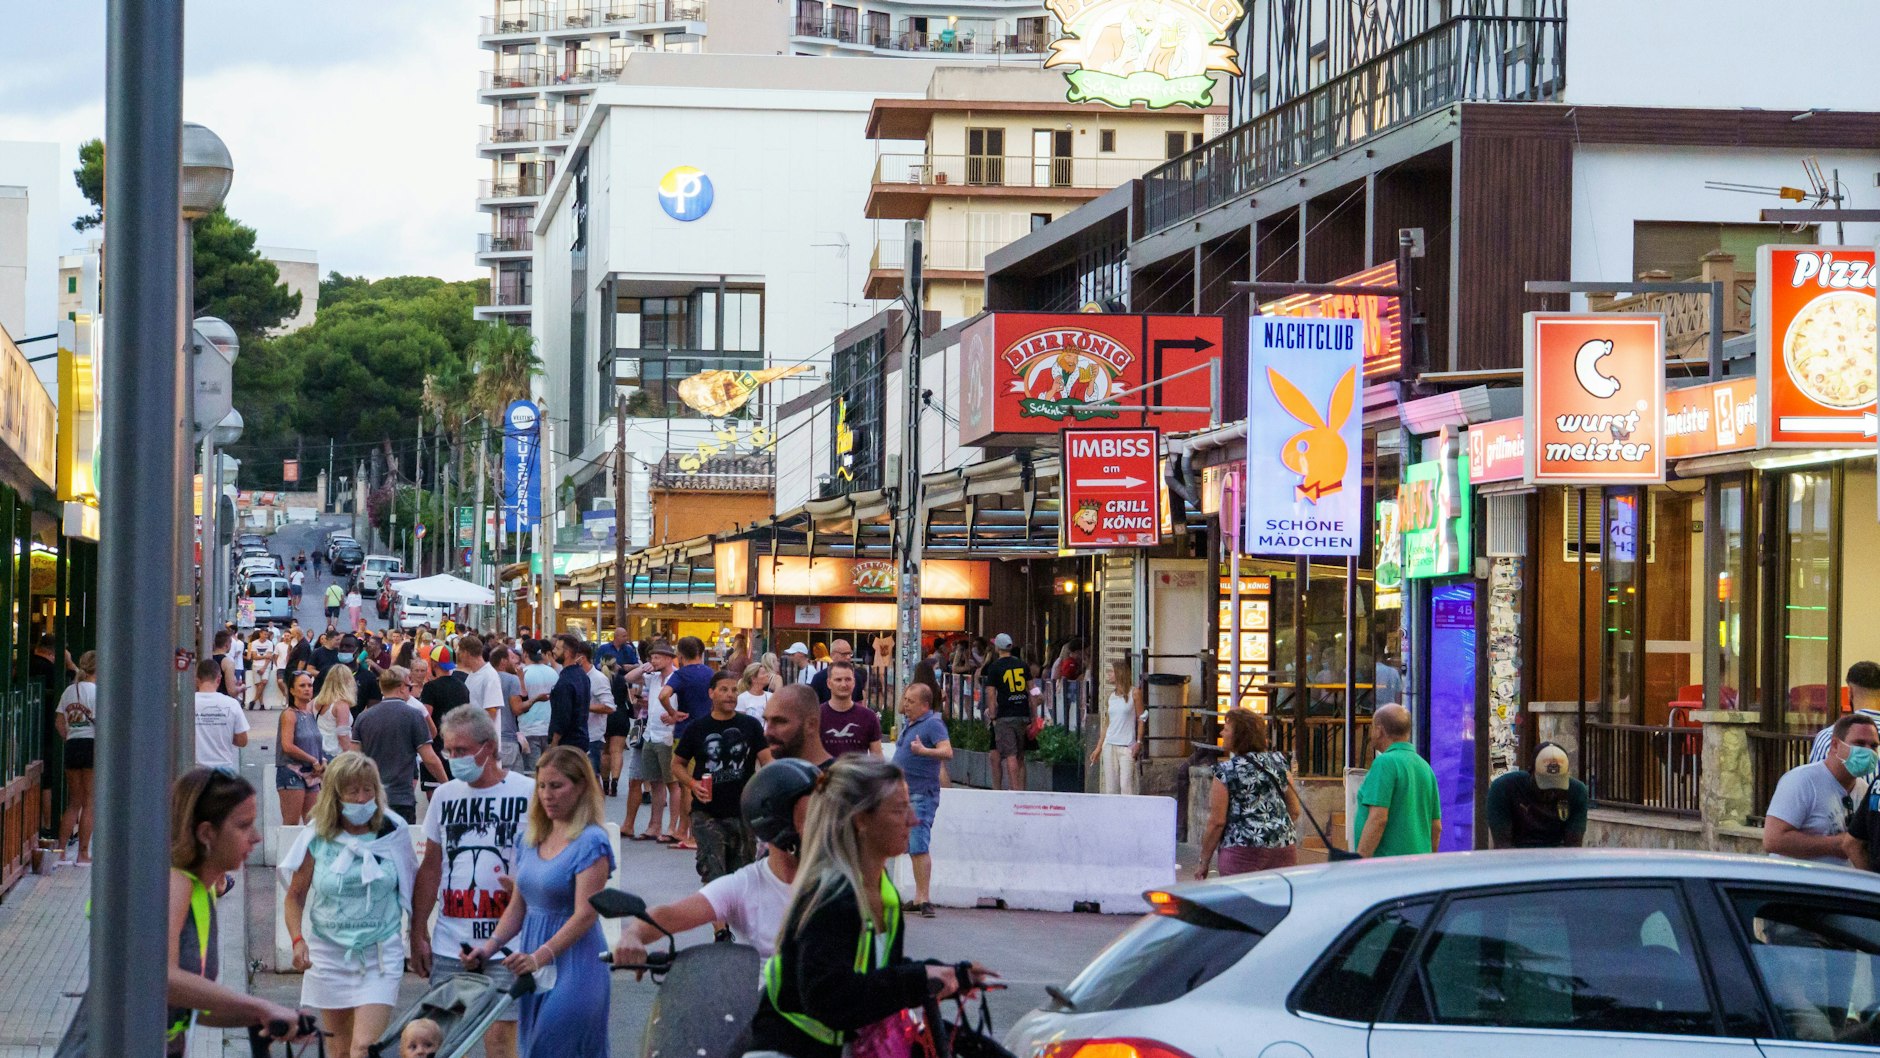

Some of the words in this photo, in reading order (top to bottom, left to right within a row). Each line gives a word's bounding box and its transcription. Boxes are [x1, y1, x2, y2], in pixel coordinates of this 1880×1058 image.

[1264, 322, 1354, 350] NACHTCLUB
[1007, 331, 1130, 366] BIERKÖNIG
[1556, 410, 1640, 434] wurst
[1072, 438, 1150, 458] IMBISS
[1545, 438, 1651, 462] meister
[1103, 465, 1120, 473] am
[1105, 500, 1149, 512] GRILL
[1102, 514, 1152, 530] KÖNIG
[1266, 516, 1344, 532] SCHÖNE
[1259, 532, 1353, 548] MÄDCHEN
[1003, 668, 1025, 692] 15
[441, 797, 497, 825] WAKE
[501, 797, 528, 823] UP
[473, 921, 499, 939] REP
